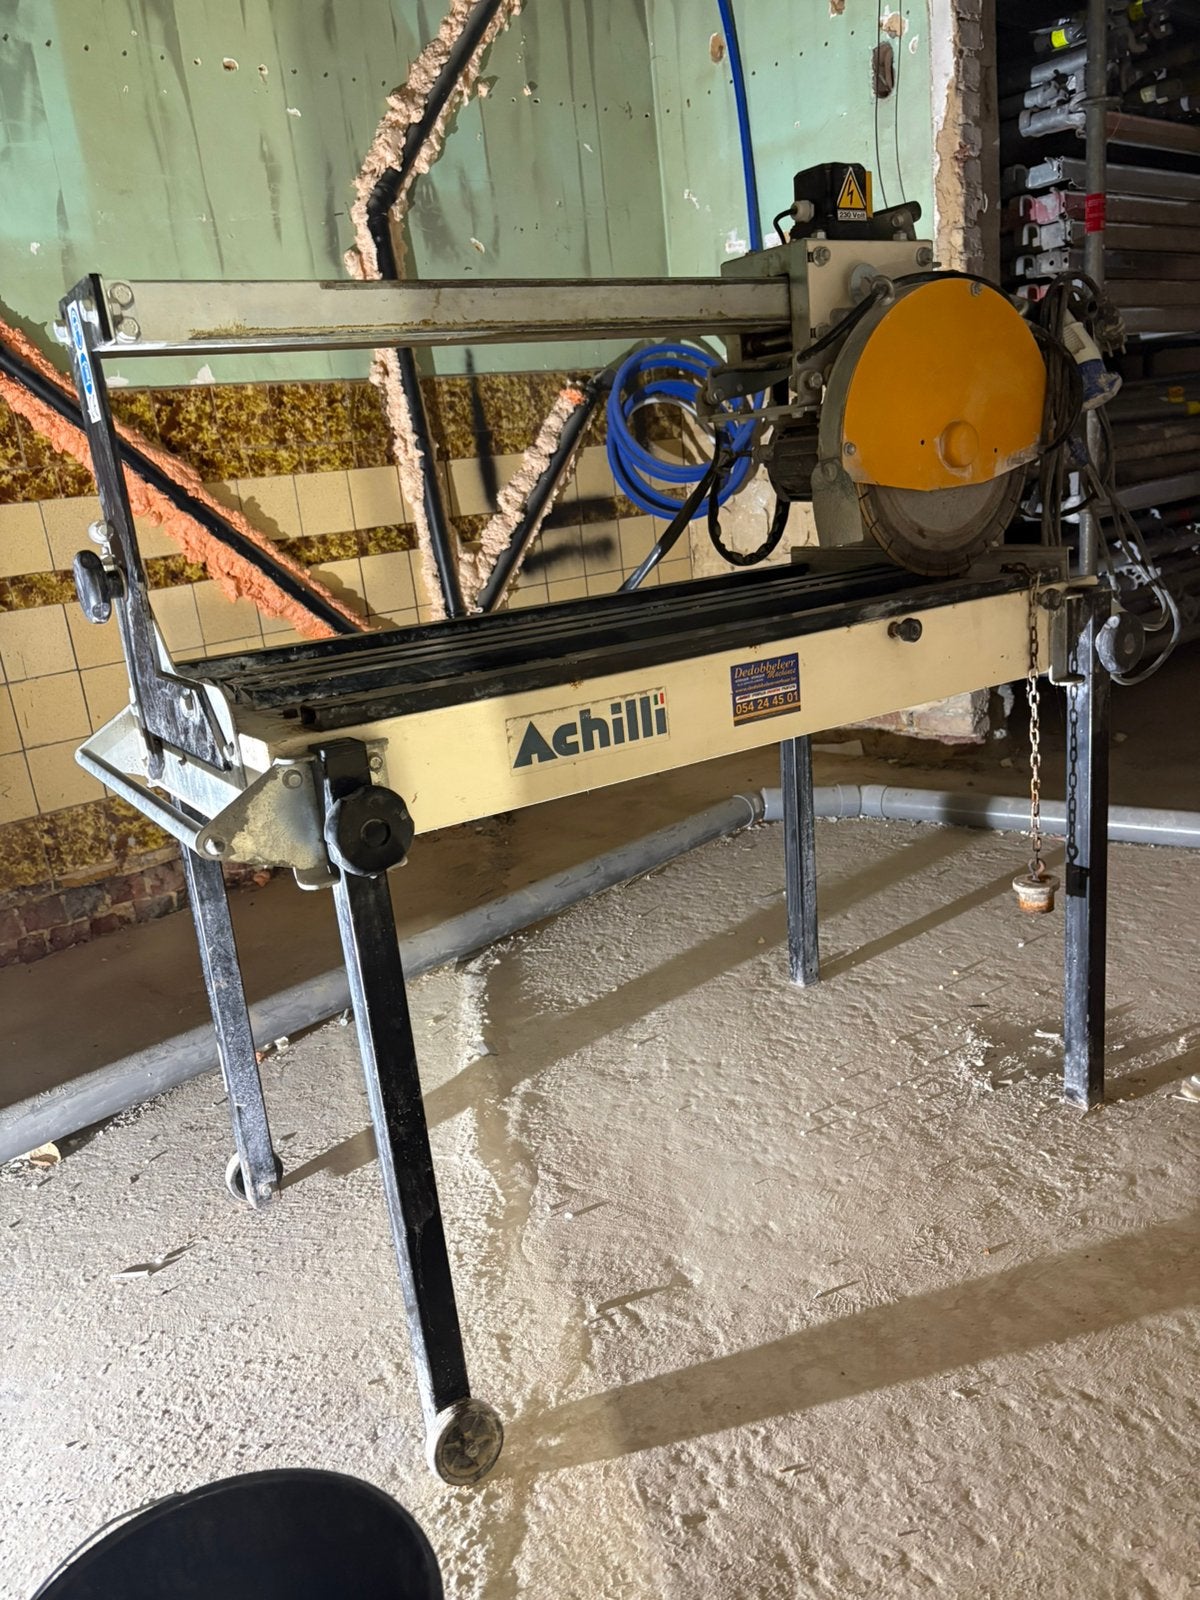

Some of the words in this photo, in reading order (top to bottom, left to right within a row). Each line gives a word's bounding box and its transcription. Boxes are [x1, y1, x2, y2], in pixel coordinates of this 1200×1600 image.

[735, 702, 754, 714] 054
[757, 698, 769, 709] 24
[772, 695, 784, 705] 45
[787, 692, 798, 702] 01
[512, 692, 667, 769] Achilli
